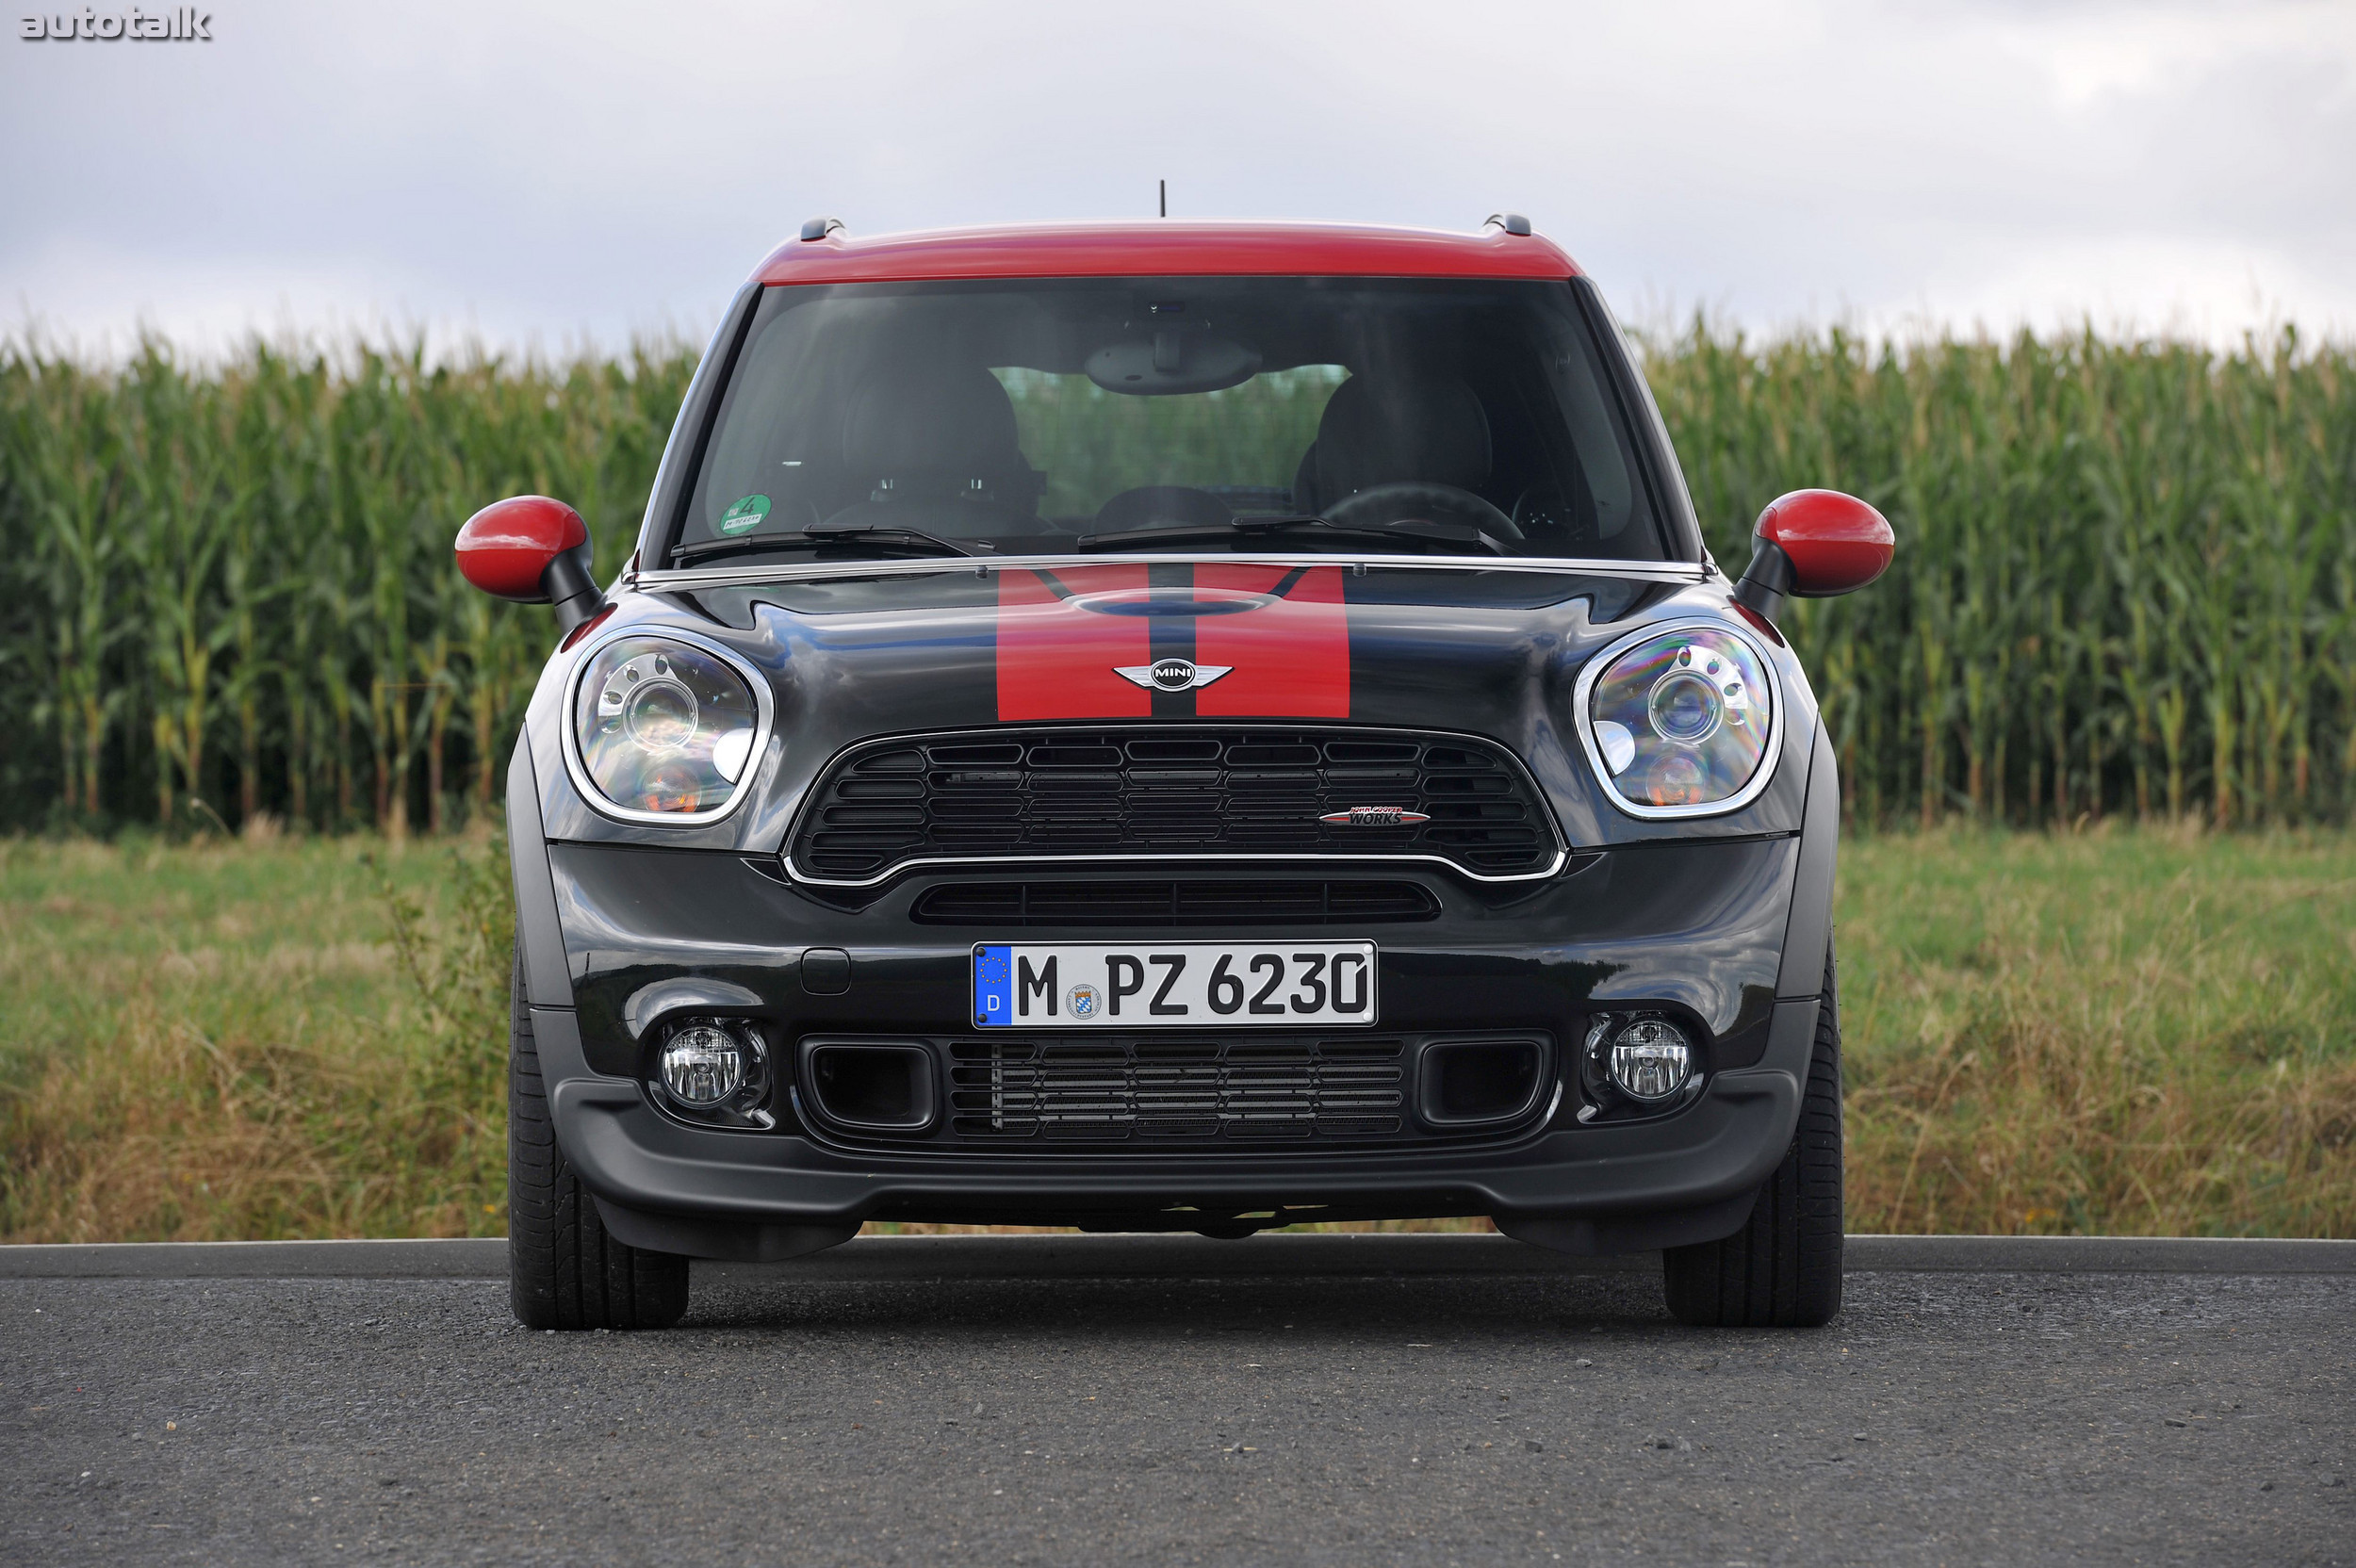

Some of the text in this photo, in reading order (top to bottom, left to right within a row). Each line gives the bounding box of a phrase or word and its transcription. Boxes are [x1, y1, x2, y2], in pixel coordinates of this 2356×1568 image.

[740, 496, 755, 514] 4
[1155, 668, 1191, 678] MINI
[1350, 813, 1402, 825] WORKS
[1018, 955, 1057, 1016] M
[1105, 954, 1188, 1016] PZ
[1207, 953, 1367, 1014] 6230
[987, 995, 1000, 1011] D
